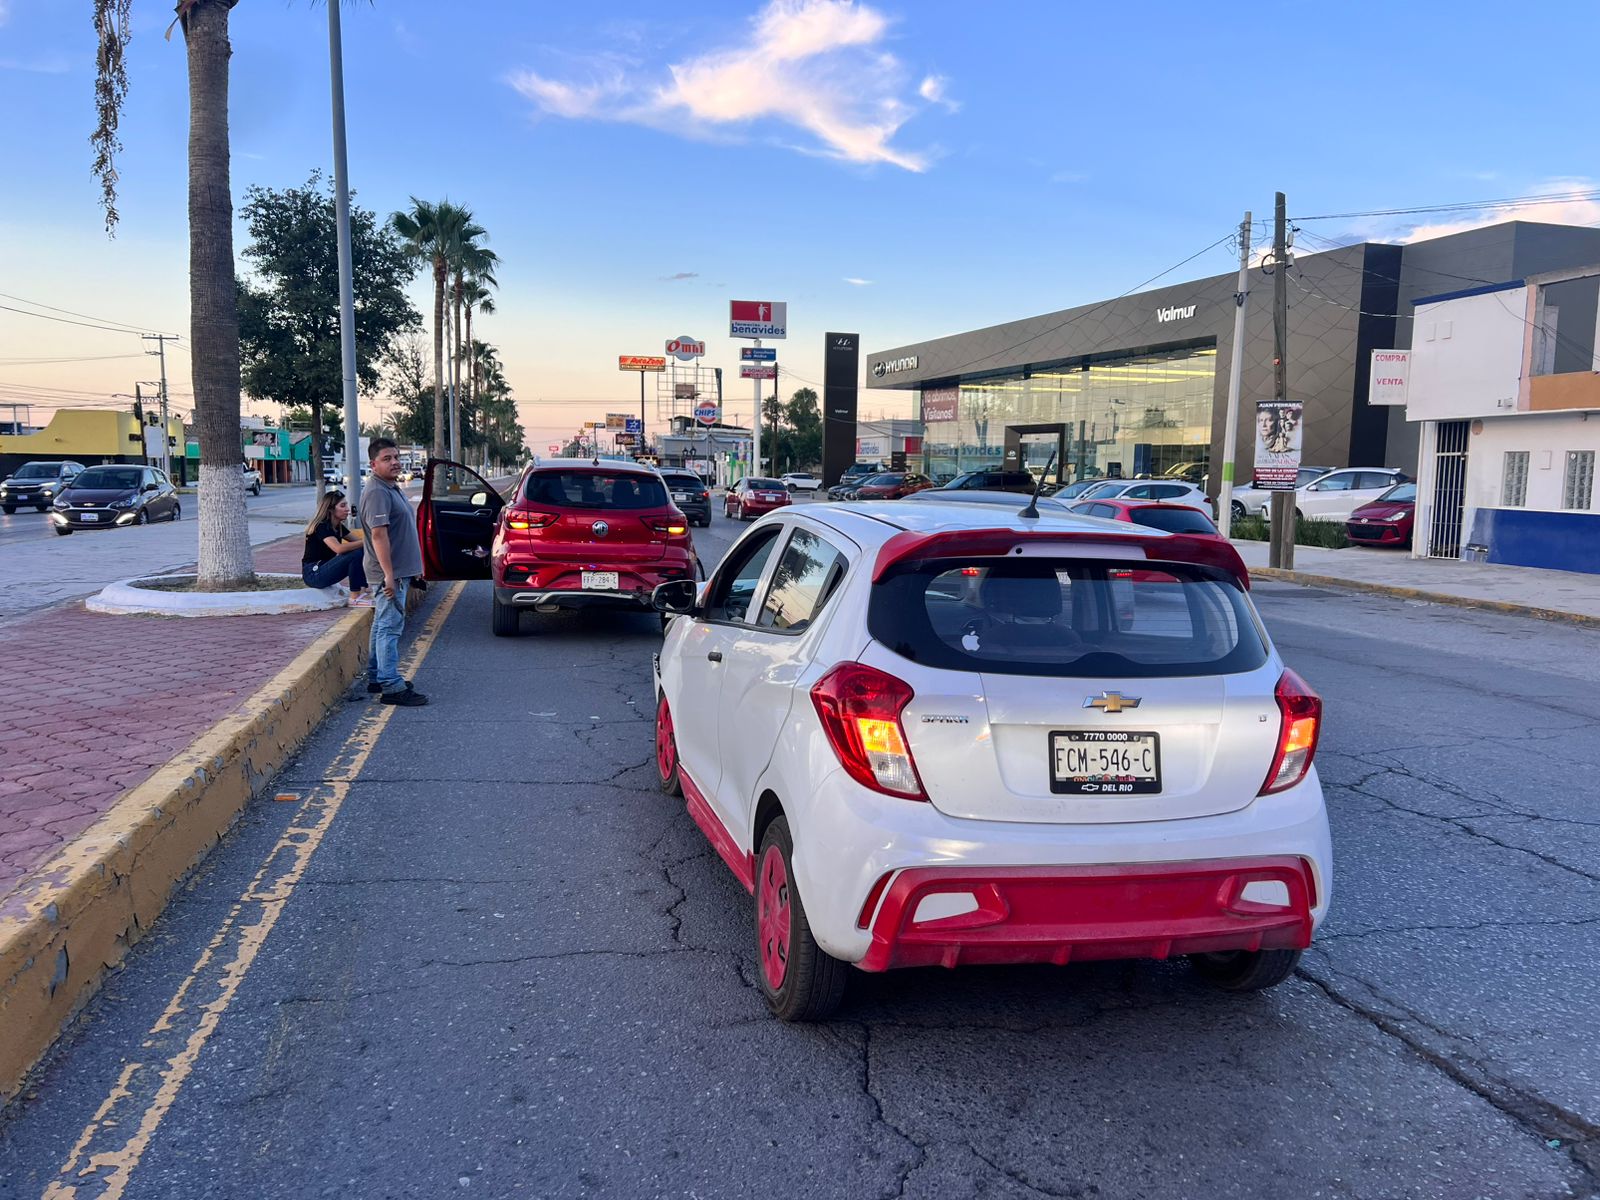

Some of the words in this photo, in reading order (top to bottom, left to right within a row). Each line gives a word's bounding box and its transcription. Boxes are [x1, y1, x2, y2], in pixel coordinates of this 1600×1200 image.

[1157, 305, 1196, 322] Valmur
[732, 323, 784, 334] benavides
[667, 340, 703, 353] Omni
[886, 355, 918, 374] HYUNDAI
[1083, 733, 1105, 741] 7770
[1106, 733, 1128, 741] 0000
[1056, 748, 1152, 772] FCM-546-C
